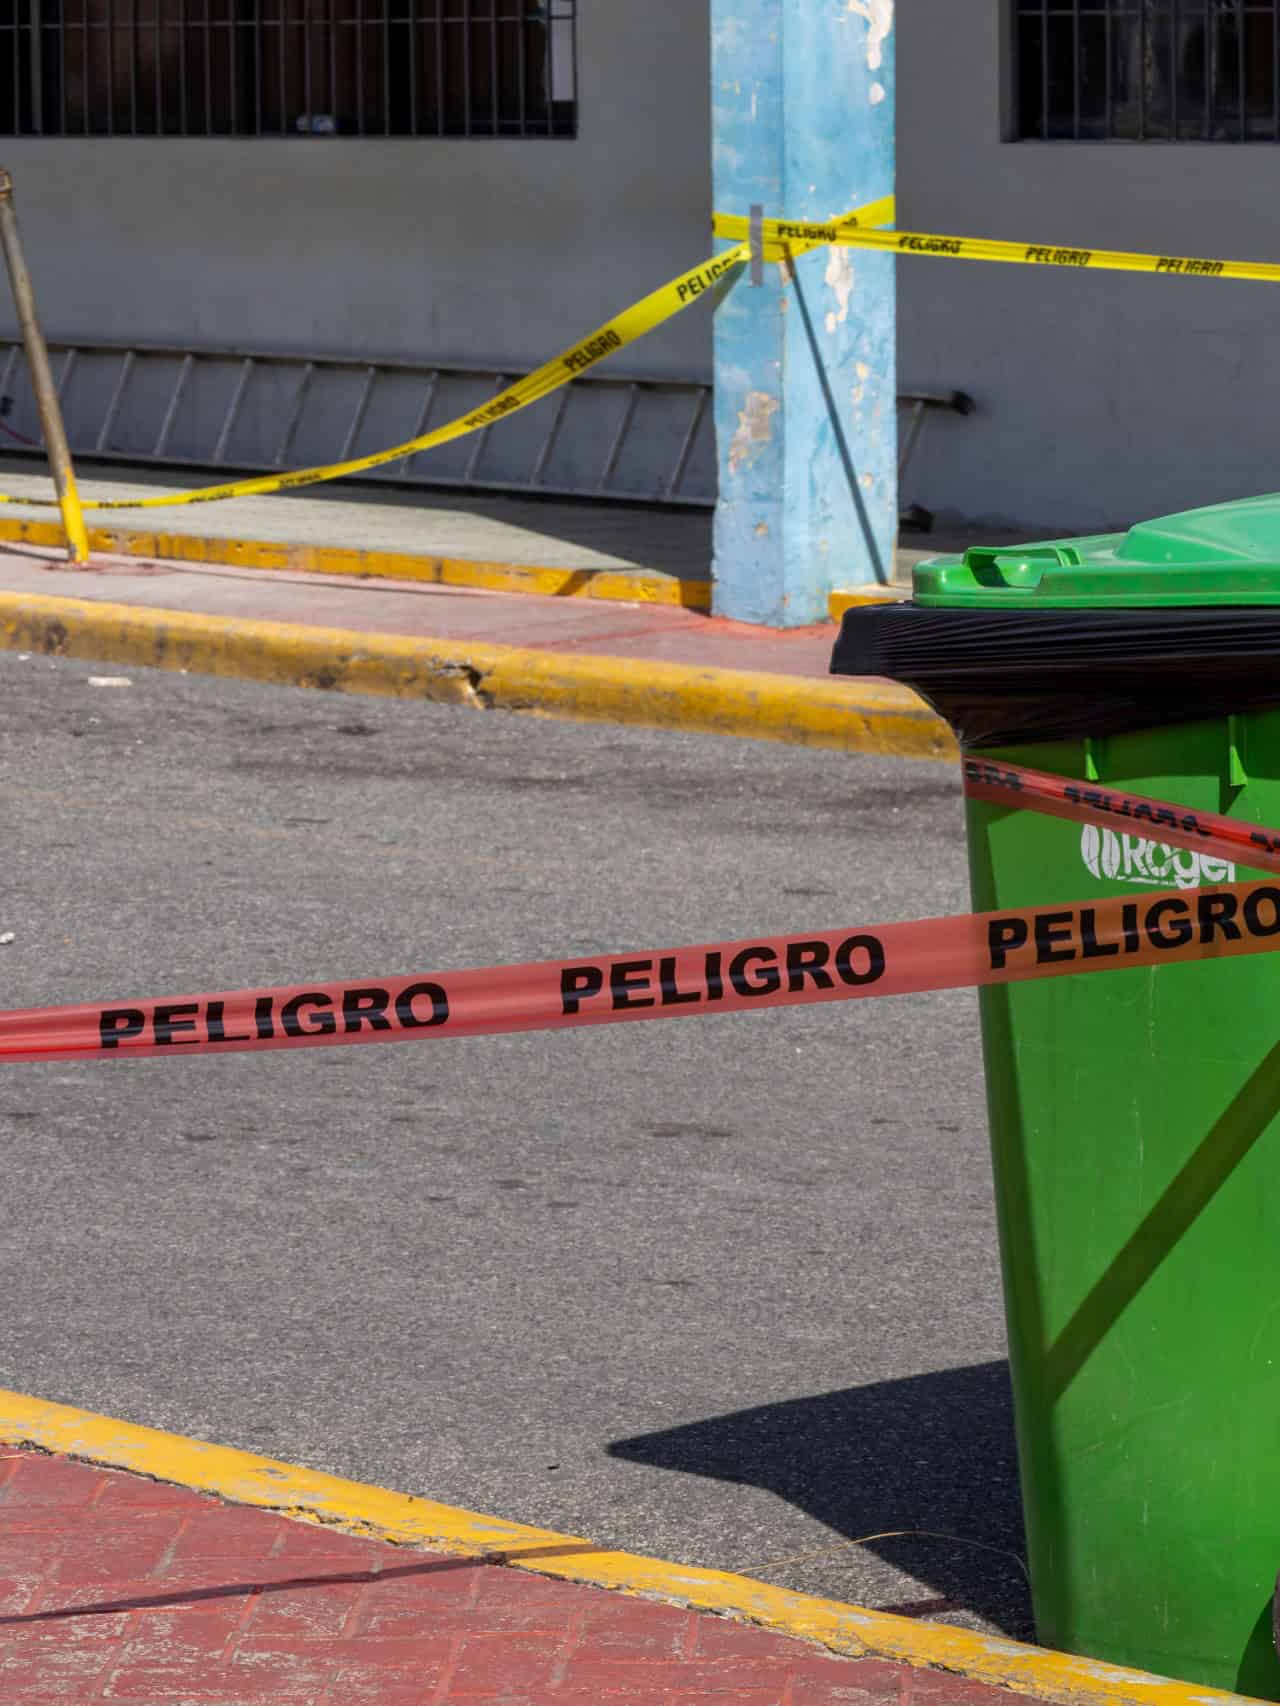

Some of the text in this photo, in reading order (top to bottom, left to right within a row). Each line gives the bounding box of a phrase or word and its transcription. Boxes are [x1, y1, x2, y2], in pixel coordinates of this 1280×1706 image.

[900, 235, 963, 255] PELIGRO
[1025, 246, 1092, 266] PELIGRO
[1155, 257, 1224, 276] PELIGRO
[562, 328, 623, 373] PELIGRO
[98, 983, 450, 1050] PELIGRO
[559, 934, 887, 1017] PELIGRO
